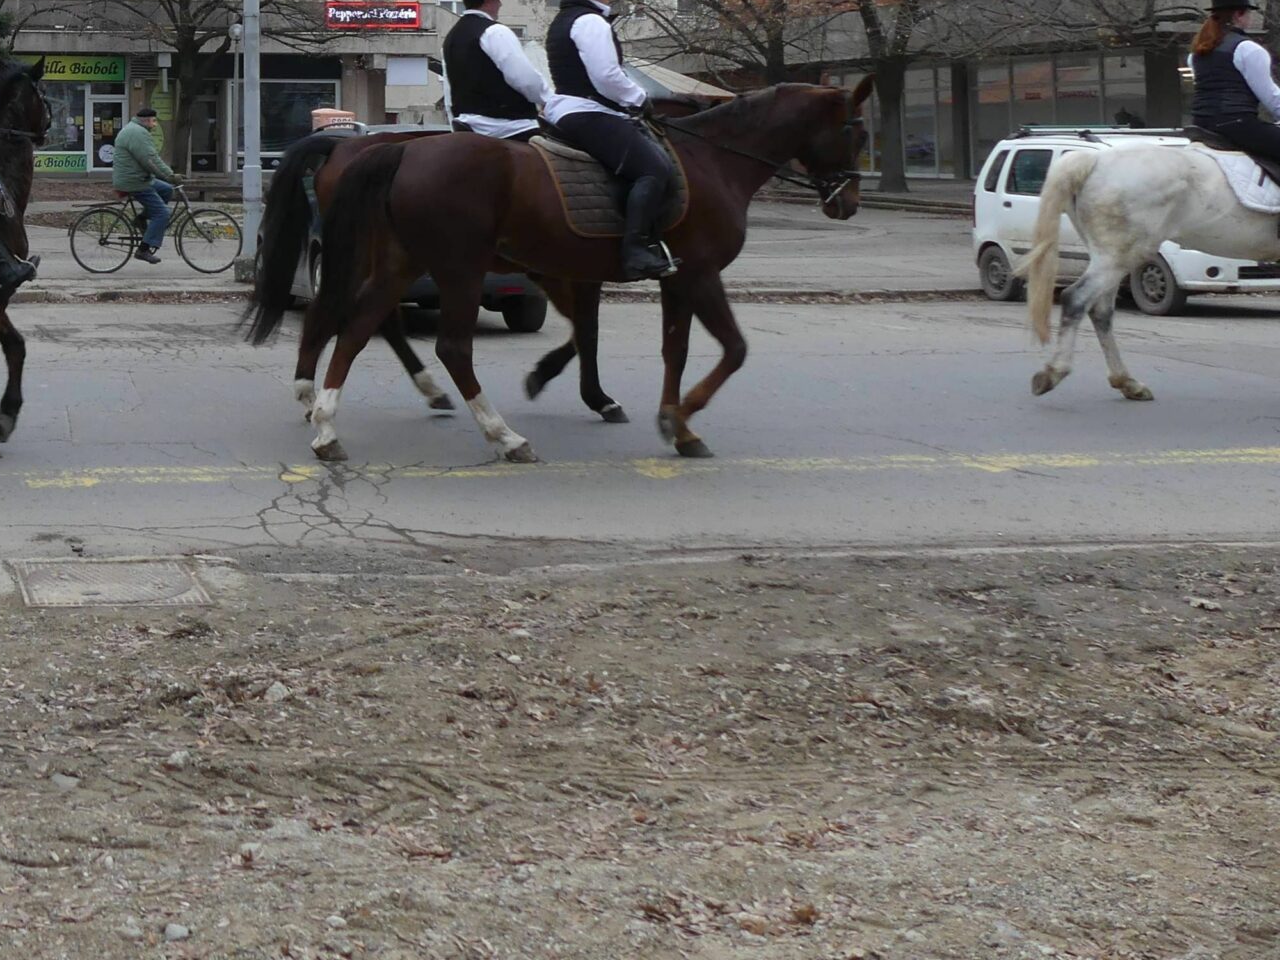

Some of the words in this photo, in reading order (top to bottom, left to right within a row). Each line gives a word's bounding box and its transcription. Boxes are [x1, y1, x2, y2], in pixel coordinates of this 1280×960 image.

[45, 60, 66, 74] illa
[69, 61, 119, 74] Biobolt
[44, 155, 85, 168] Biobolt
